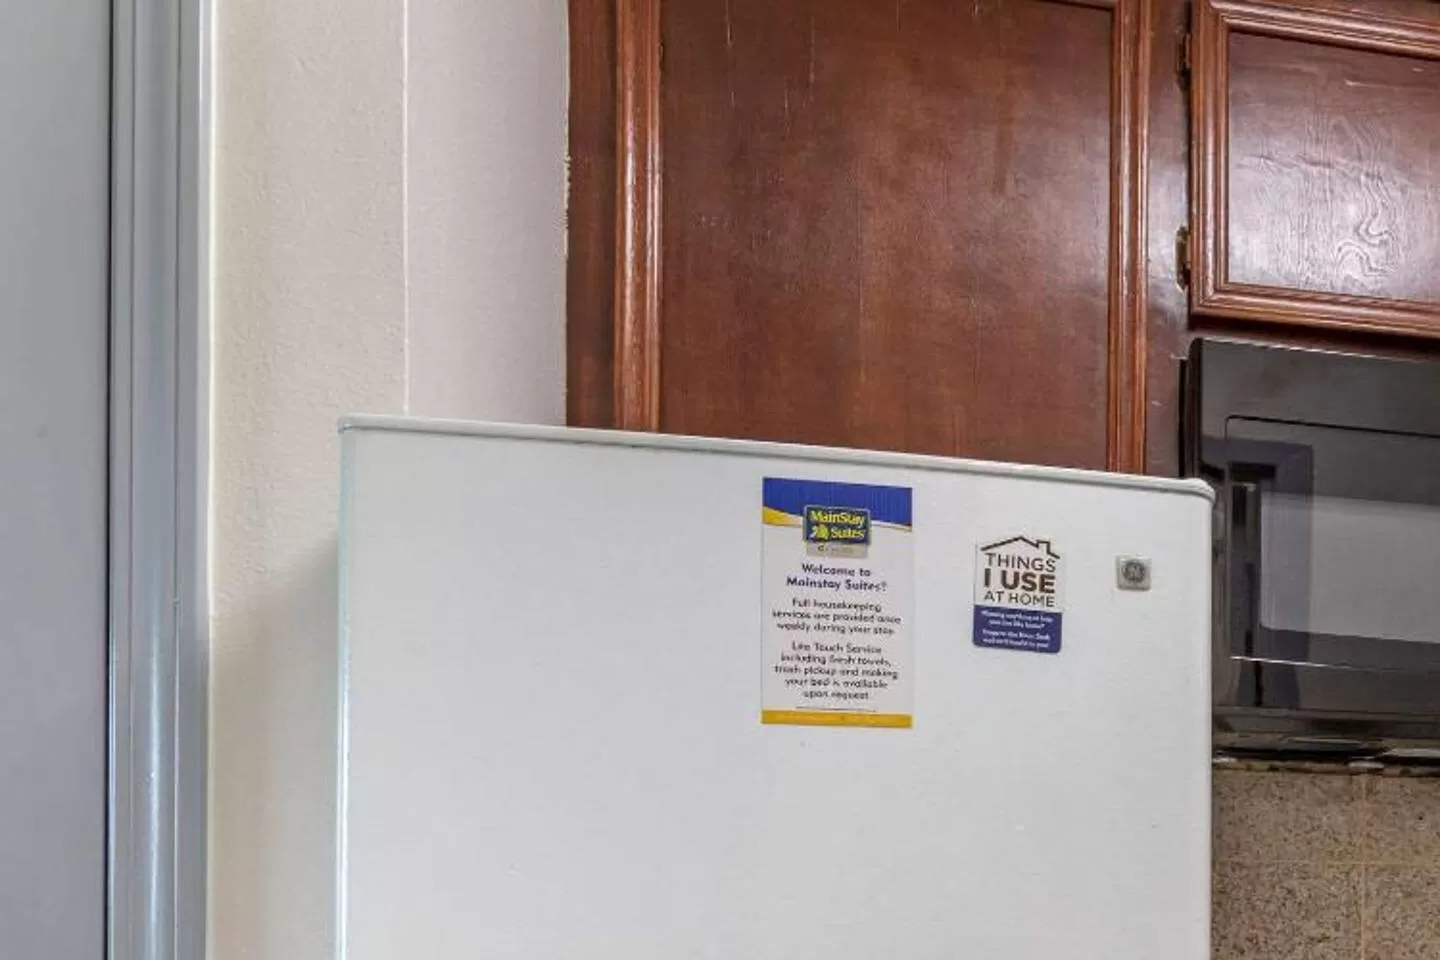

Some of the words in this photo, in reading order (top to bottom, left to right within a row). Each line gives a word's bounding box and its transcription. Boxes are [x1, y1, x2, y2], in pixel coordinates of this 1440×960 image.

[810, 510, 865, 528] MainStay
[831, 528, 864, 538] Suites
[802, 564, 855, 576] Welcome
[859, 568, 871, 577] to
[984, 553, 1056, 573] THINGS
[786, 577, 841, 590] Mainstay
[984, 568, 991, 587] I
[1001, 572, 1056, 594] USE
[984, 591, 1004, 602] AT
[1008, 593, 1055, 607] HOME
